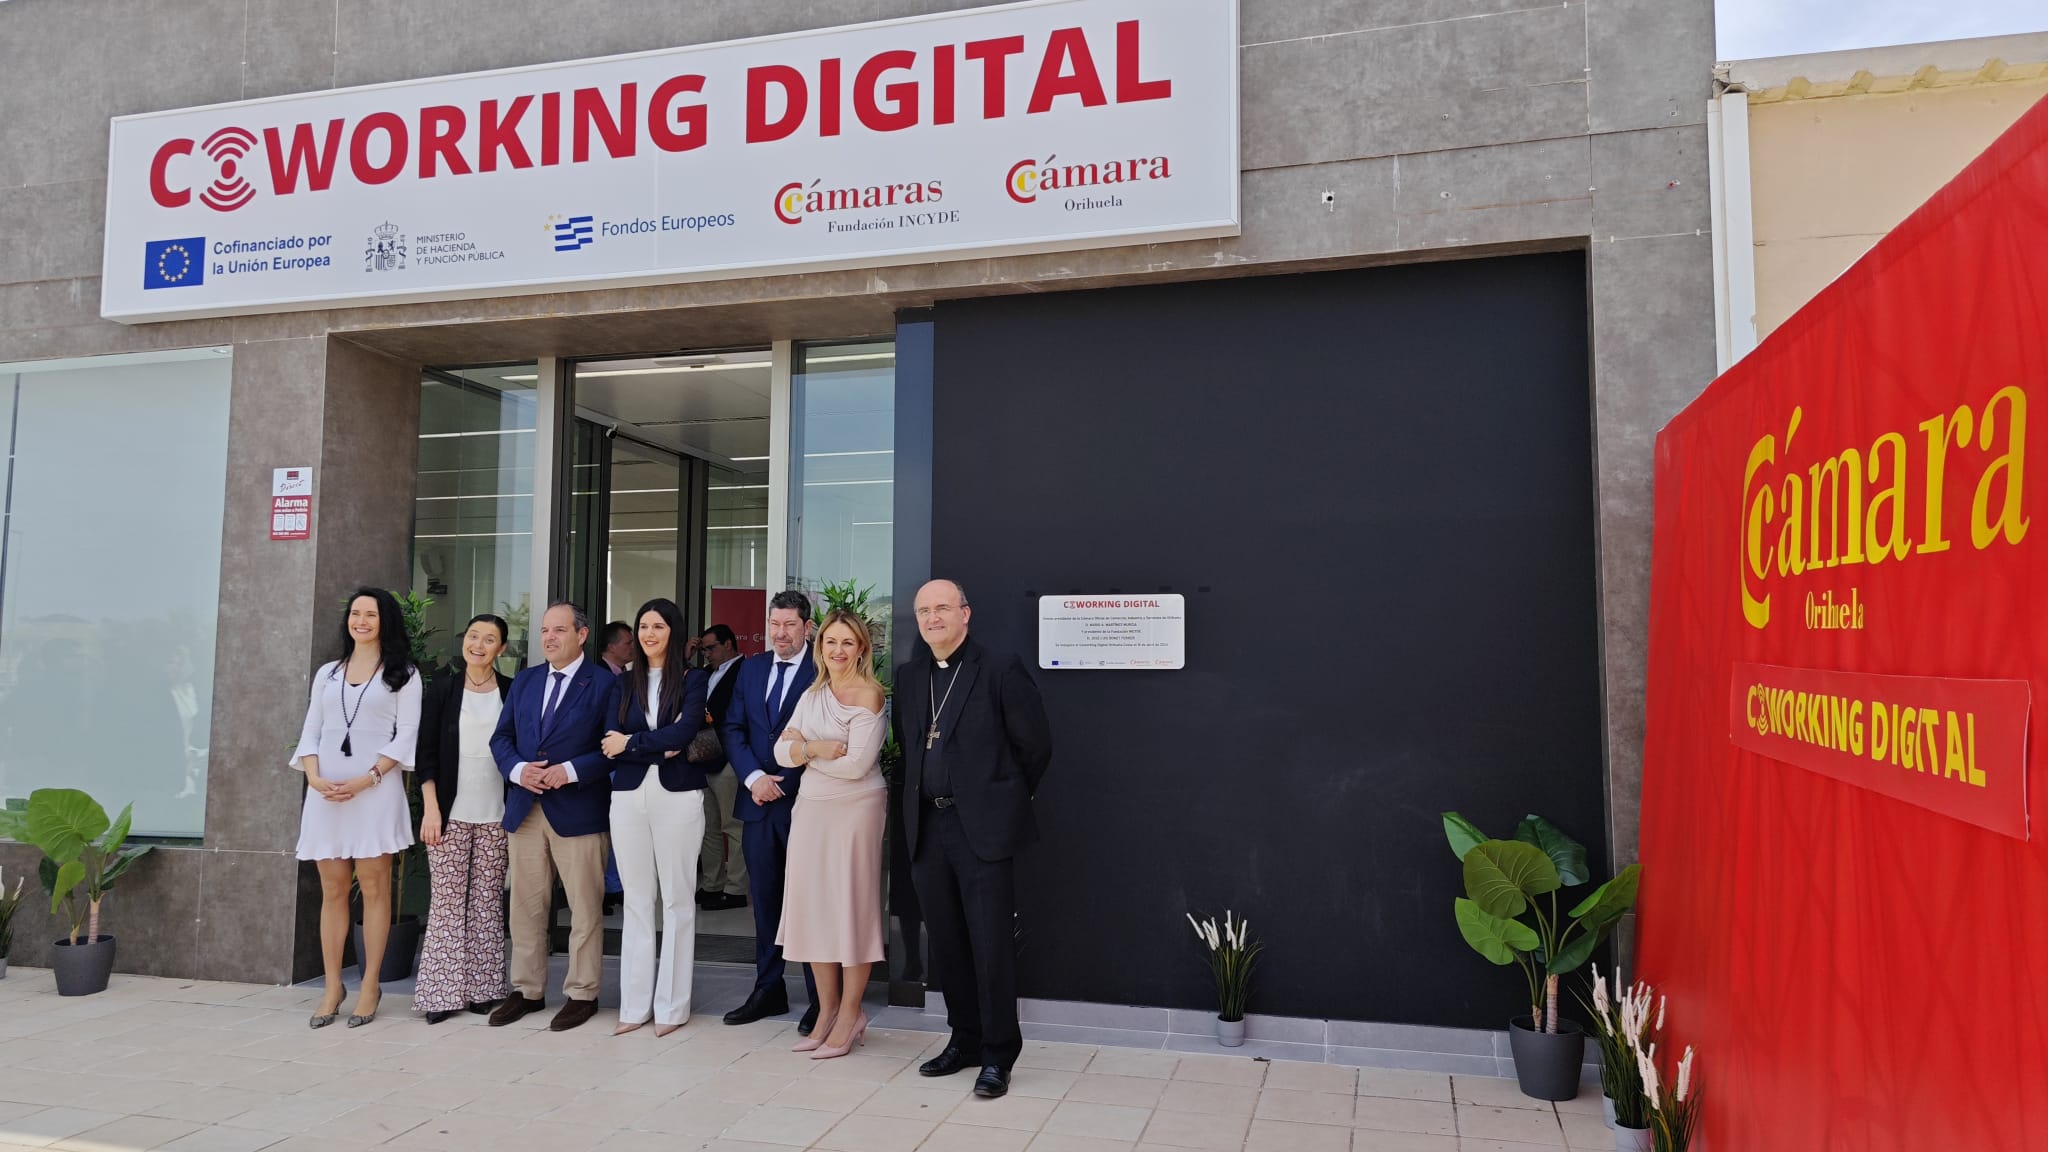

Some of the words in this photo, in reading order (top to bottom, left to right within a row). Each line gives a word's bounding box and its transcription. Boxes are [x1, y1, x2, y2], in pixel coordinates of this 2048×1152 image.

[746, 19, 1172, 144] DIGITAL
[1064, 195, 1123, 212] Orihuela
[601, 217, 657, 237] Fondos
[661, 211, 736, 233] Europeos
[827, 217, 895, 234] Fundación
[898, 210, 961, 229] INCYDE
[213, 235, 305, 255] Cofinanciado
[308, 235, 332, 250] por
[416, 232, 466, 244] MINISTERIO
[416, 246, 427, 255] DE
[430, 242, 477, 254] HACIENDA
[416, 258, 422, 266] Y
[424, 252, 466, 265] FUNCIÓN
[468, 250, 506, 262] PÚBLICA
[213, 262, 224, 275] la
[228, 259, 268, 274] Unión
[272, 256, 331, 271] Europea
[275, 497, 308, 508] Alarma
[1123, 600, 1160, 608] DIGITAL
[1805, 587, 1864, 630] Orihuela
[1871, 701, 1986, 787] DIGITAL
